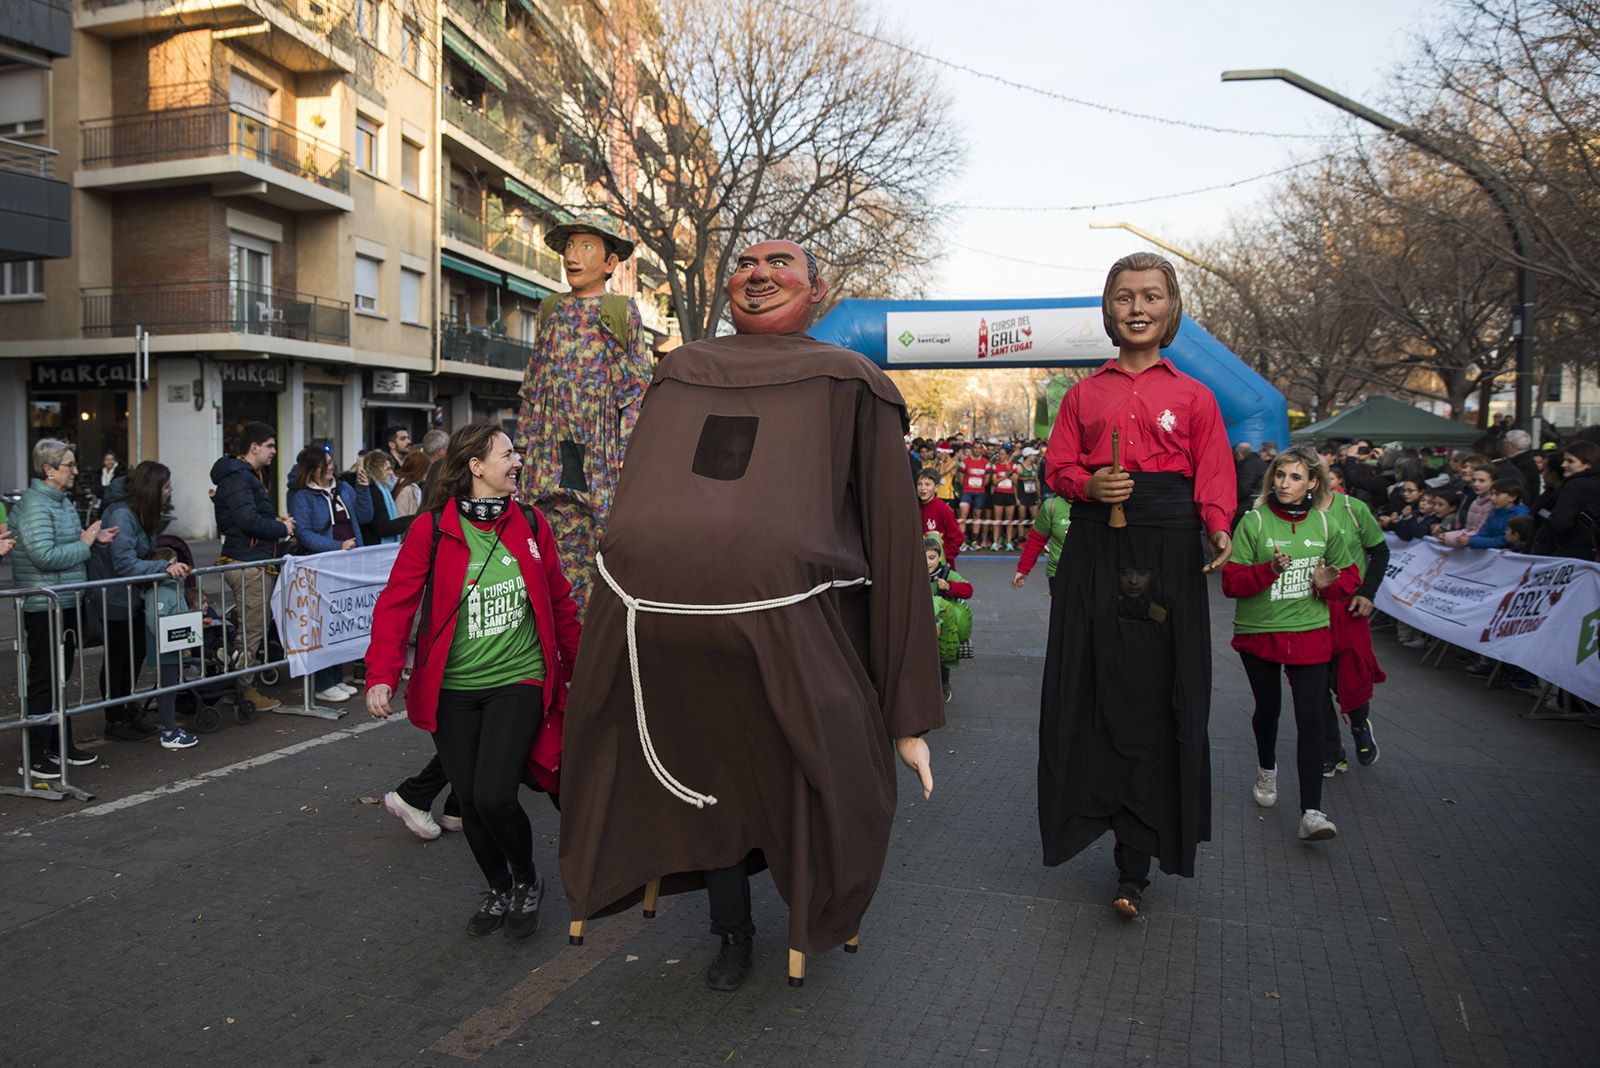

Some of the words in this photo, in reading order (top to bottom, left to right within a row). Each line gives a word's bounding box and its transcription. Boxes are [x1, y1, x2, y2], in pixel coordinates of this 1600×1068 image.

[991, 318, 1016, 332] CURSA
[1017, 315, 1031, 327] DEL
[991, 328, 1022, 348] GALL
[990, 345, 1009, 357] SANT
[1010, 340, 1033, 352] CUGAT
[1287, 557, 1310, 570] URSA
[1284, 567, 1310, 585] GALL
[483, 579, 515, 600] CURSA
[329, 596, 353, 614] CLUB
[354, 591, 381, 610] MUN
[484, 591, 521, 618] GALL
[1506, 589, 1552, 618] GALL
[328, 617, 355, 637] SANT
[358, 614, 373, 630] CU
[484, 613, 507, 628] SANT
[476, 629, 484, 638] DE
